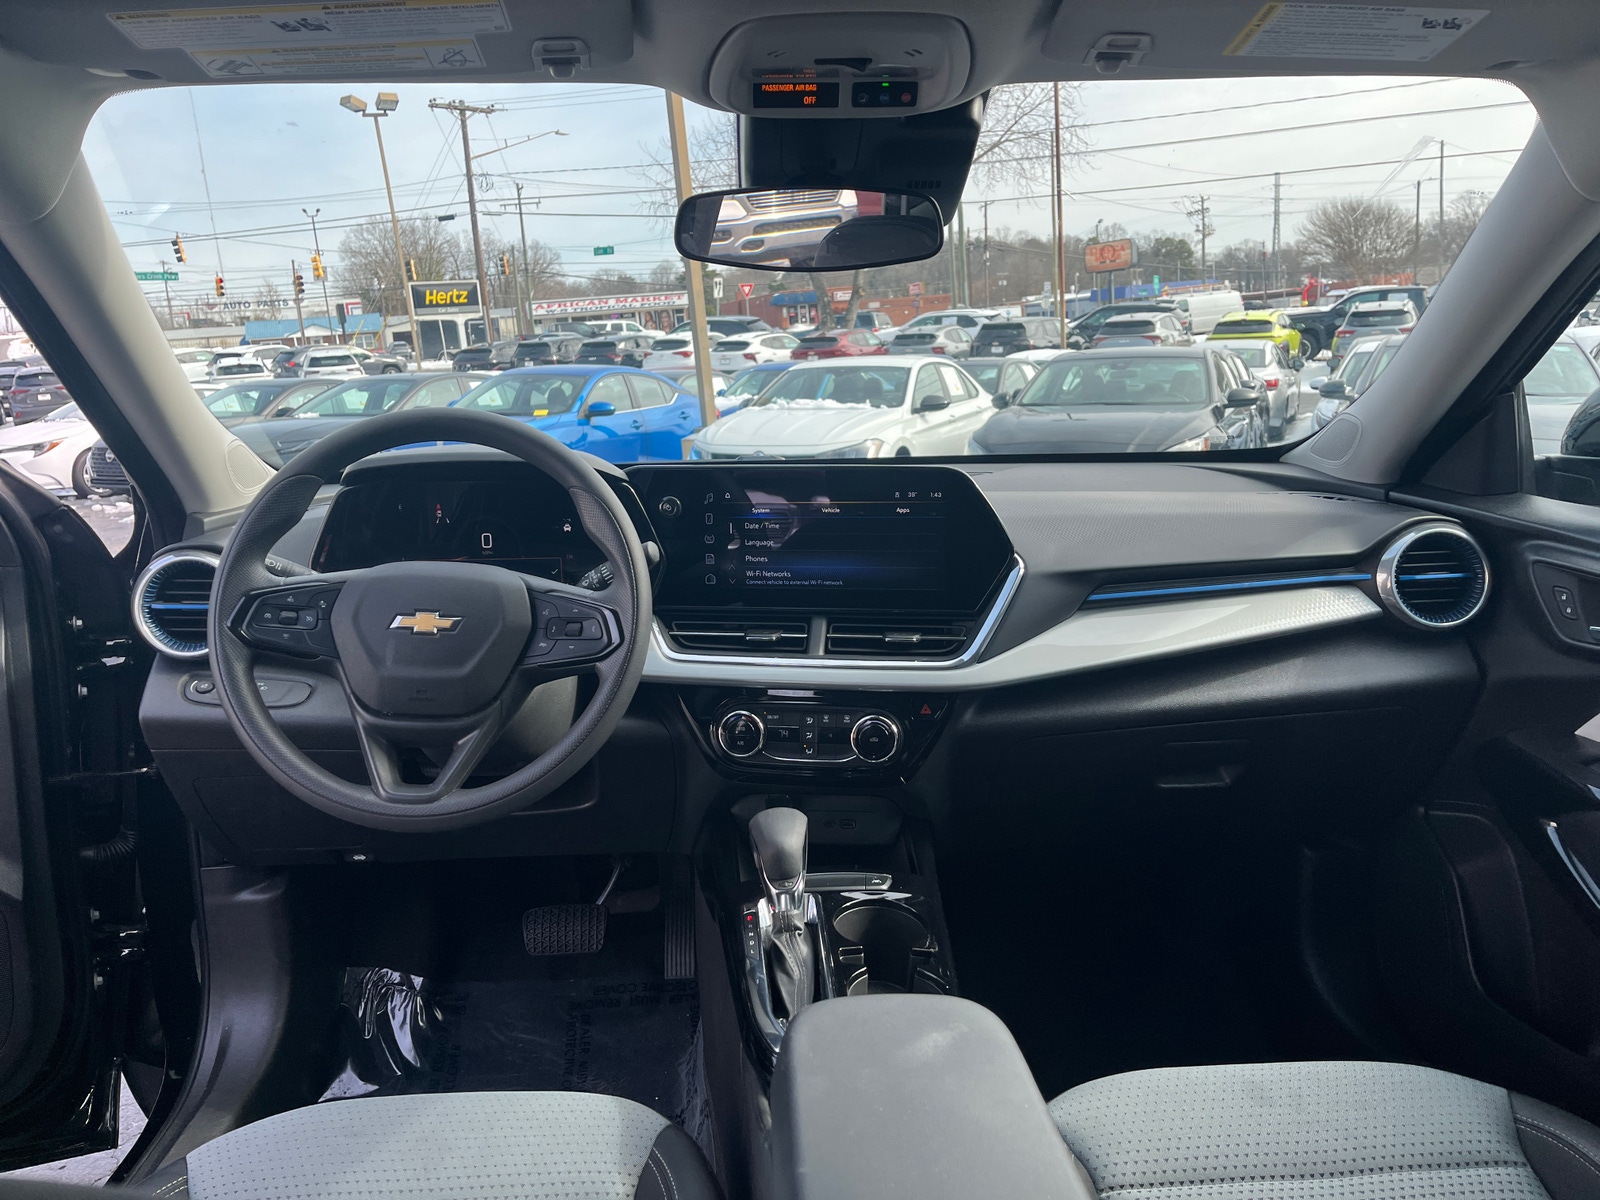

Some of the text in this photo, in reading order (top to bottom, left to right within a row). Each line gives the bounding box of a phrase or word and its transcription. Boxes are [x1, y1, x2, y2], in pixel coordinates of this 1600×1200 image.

[803, 96, 817, 105] OFF
[425, 288, 468, 305] Hertz
[535, 294, 684, 310] AFRICAN MARKET
[223, 299, 289, 310] AUTO PARTS
[570, 302, 637, 312] TROPICAL
[640, 300, 677, 308] FOOD
[481, 533, 493, 549] 0
[744, 539, 774, 548] Language
[762, 570, 792, 578] Networks
